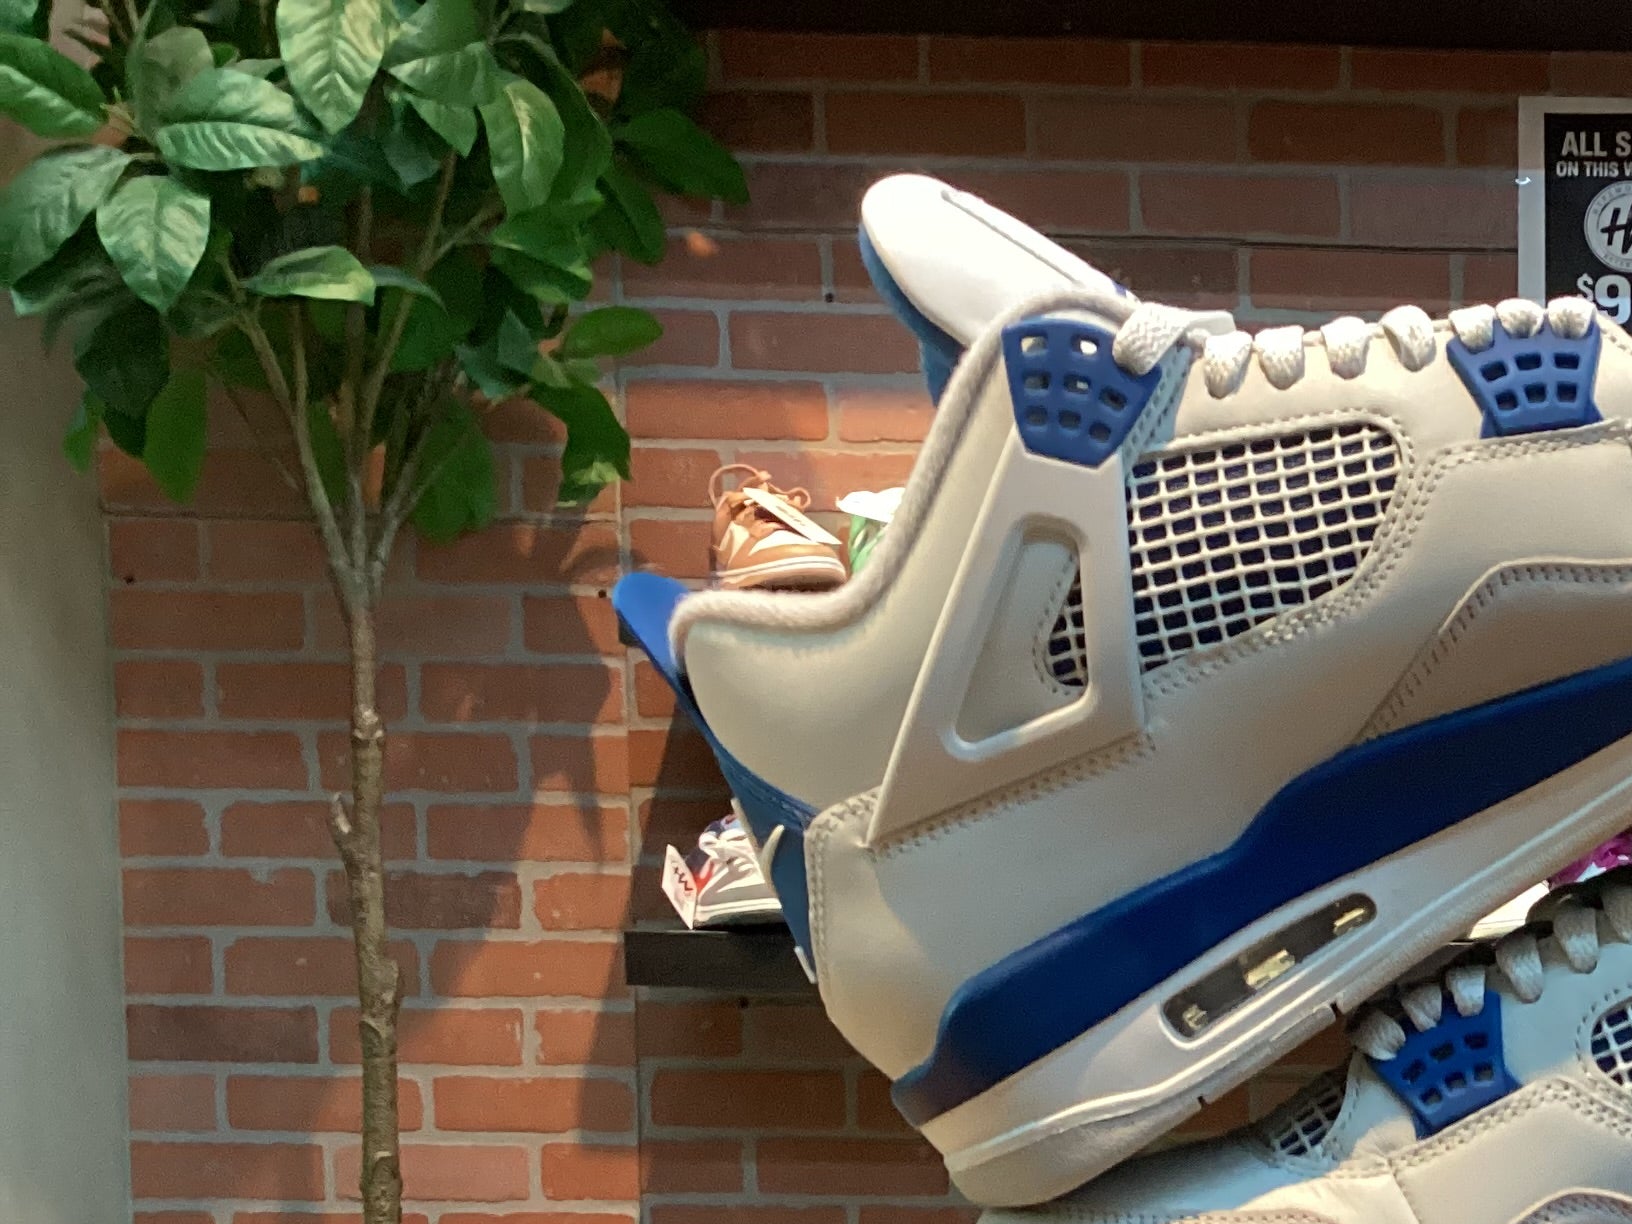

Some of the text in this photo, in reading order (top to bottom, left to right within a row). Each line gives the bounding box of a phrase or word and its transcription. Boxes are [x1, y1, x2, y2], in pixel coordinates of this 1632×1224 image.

[1561, 130, 1608, 157] ALL
[1556, 160, 1579, 177] ON
[1583, 160, 1619, 178] THIS
